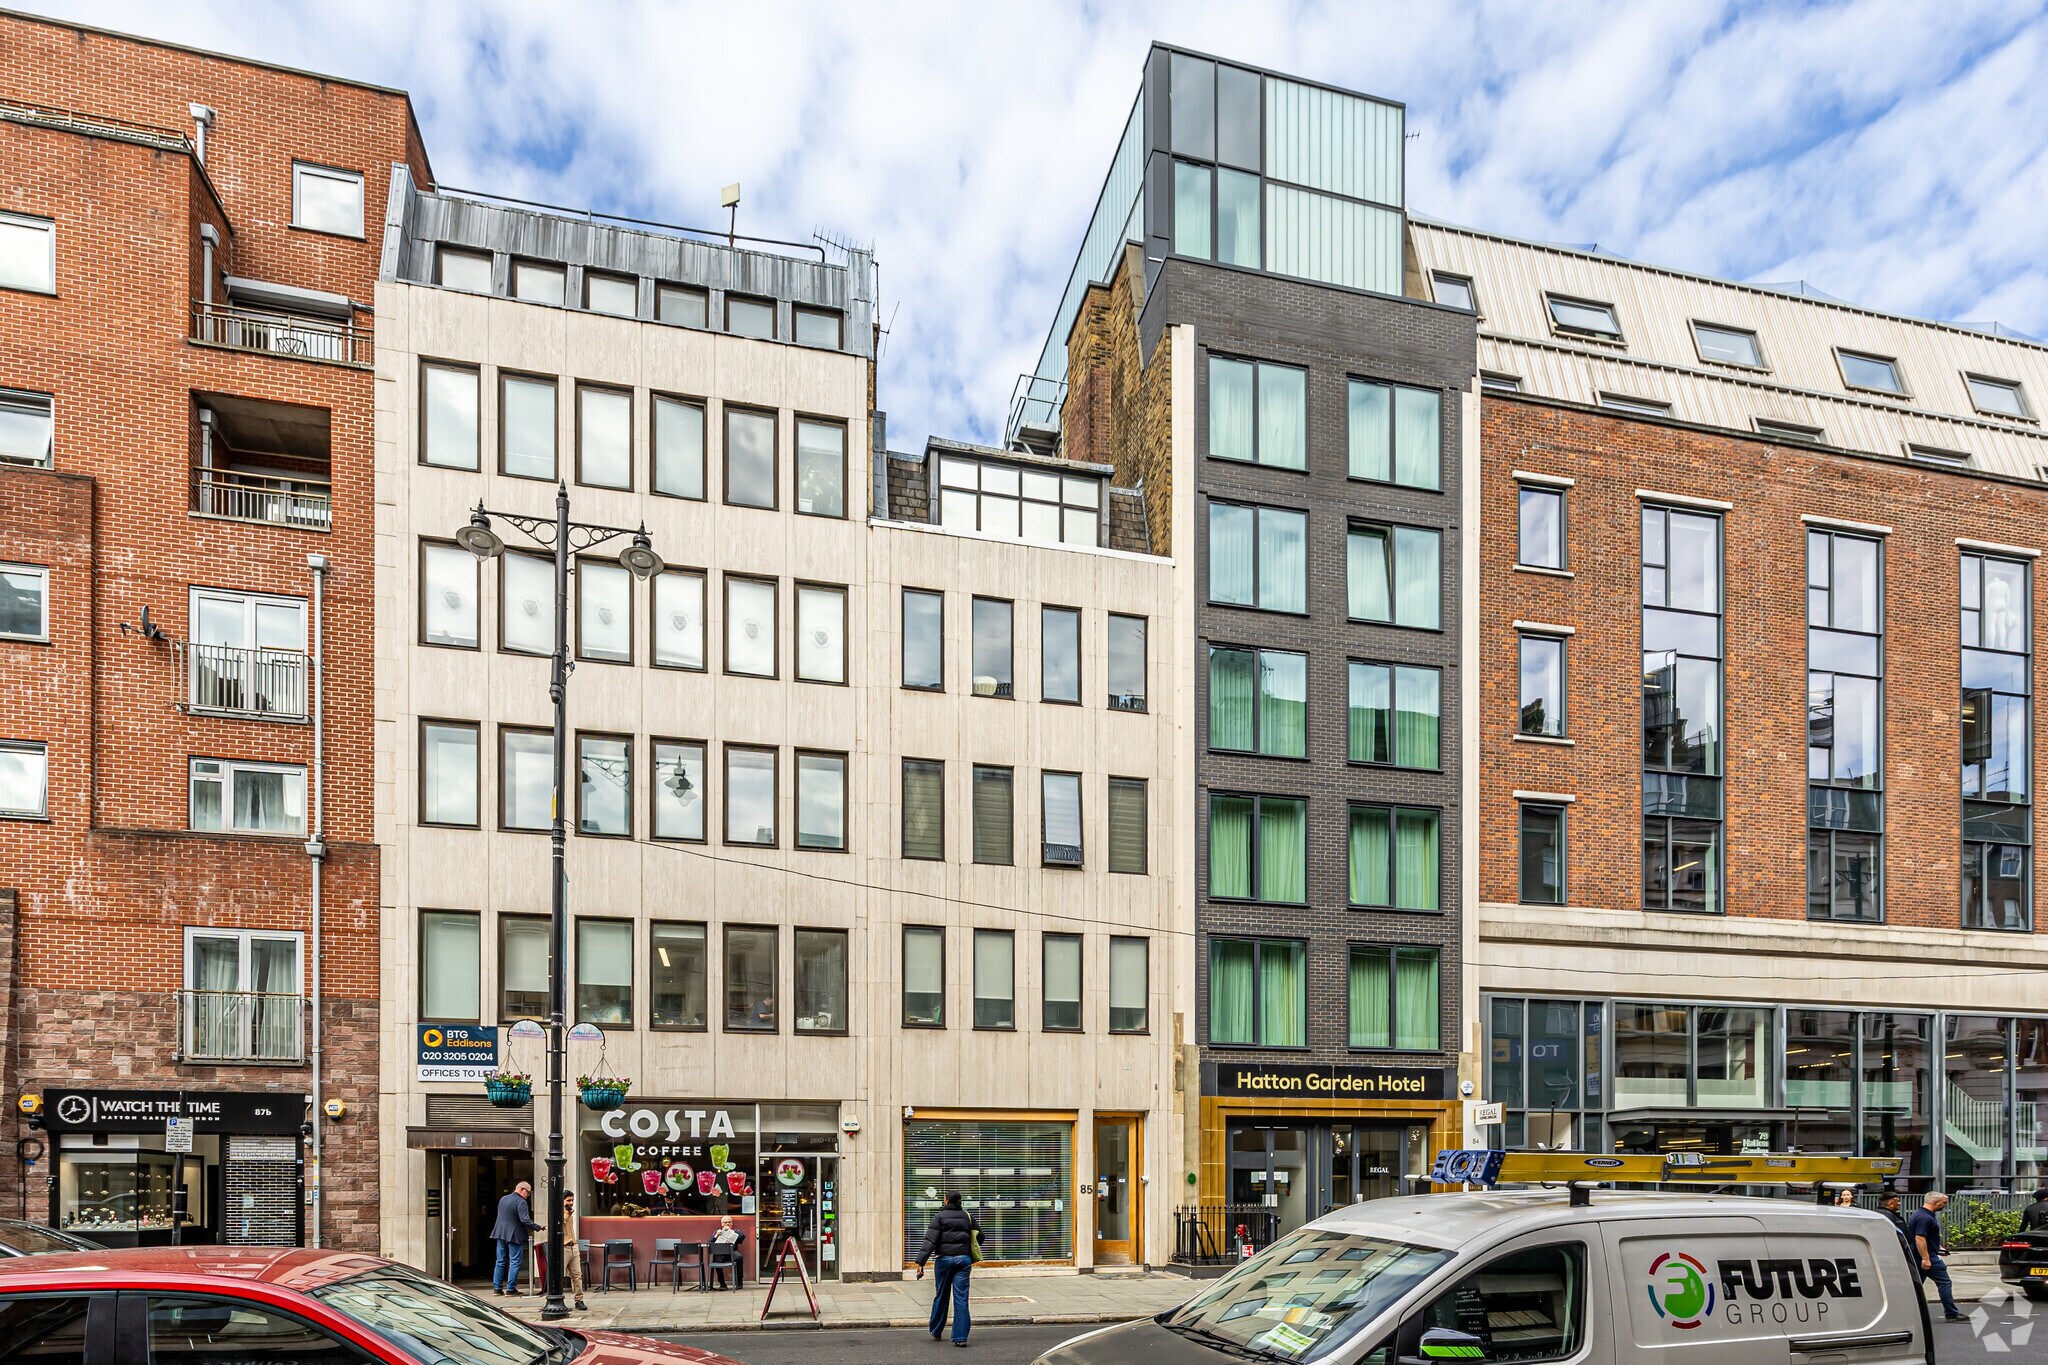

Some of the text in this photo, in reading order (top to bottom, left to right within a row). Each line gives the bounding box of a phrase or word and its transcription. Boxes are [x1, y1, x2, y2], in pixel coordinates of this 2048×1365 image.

[446, 1030, 468, 1038] BTG
[446, 1039, 492, 1048] Eddisons
[422, 1052, 493, 1061] 020 3205 0204
[422, 1069, 460, 1077] OFFICES
[1236, 1072, 1425, 1092] Hatton Garden Hotel
[100, 1101, 220, 1113] WATCH THE TIME
[601, 1109, 735, 1142] COSTA
[636, 1146, 702, 1156] COFFEE
[1080, 1184, 1092, 1194] 85
[1717, 1258, 1863, 1300] FUTURE
[1726, 1302, 1828, 1324] GROUP
